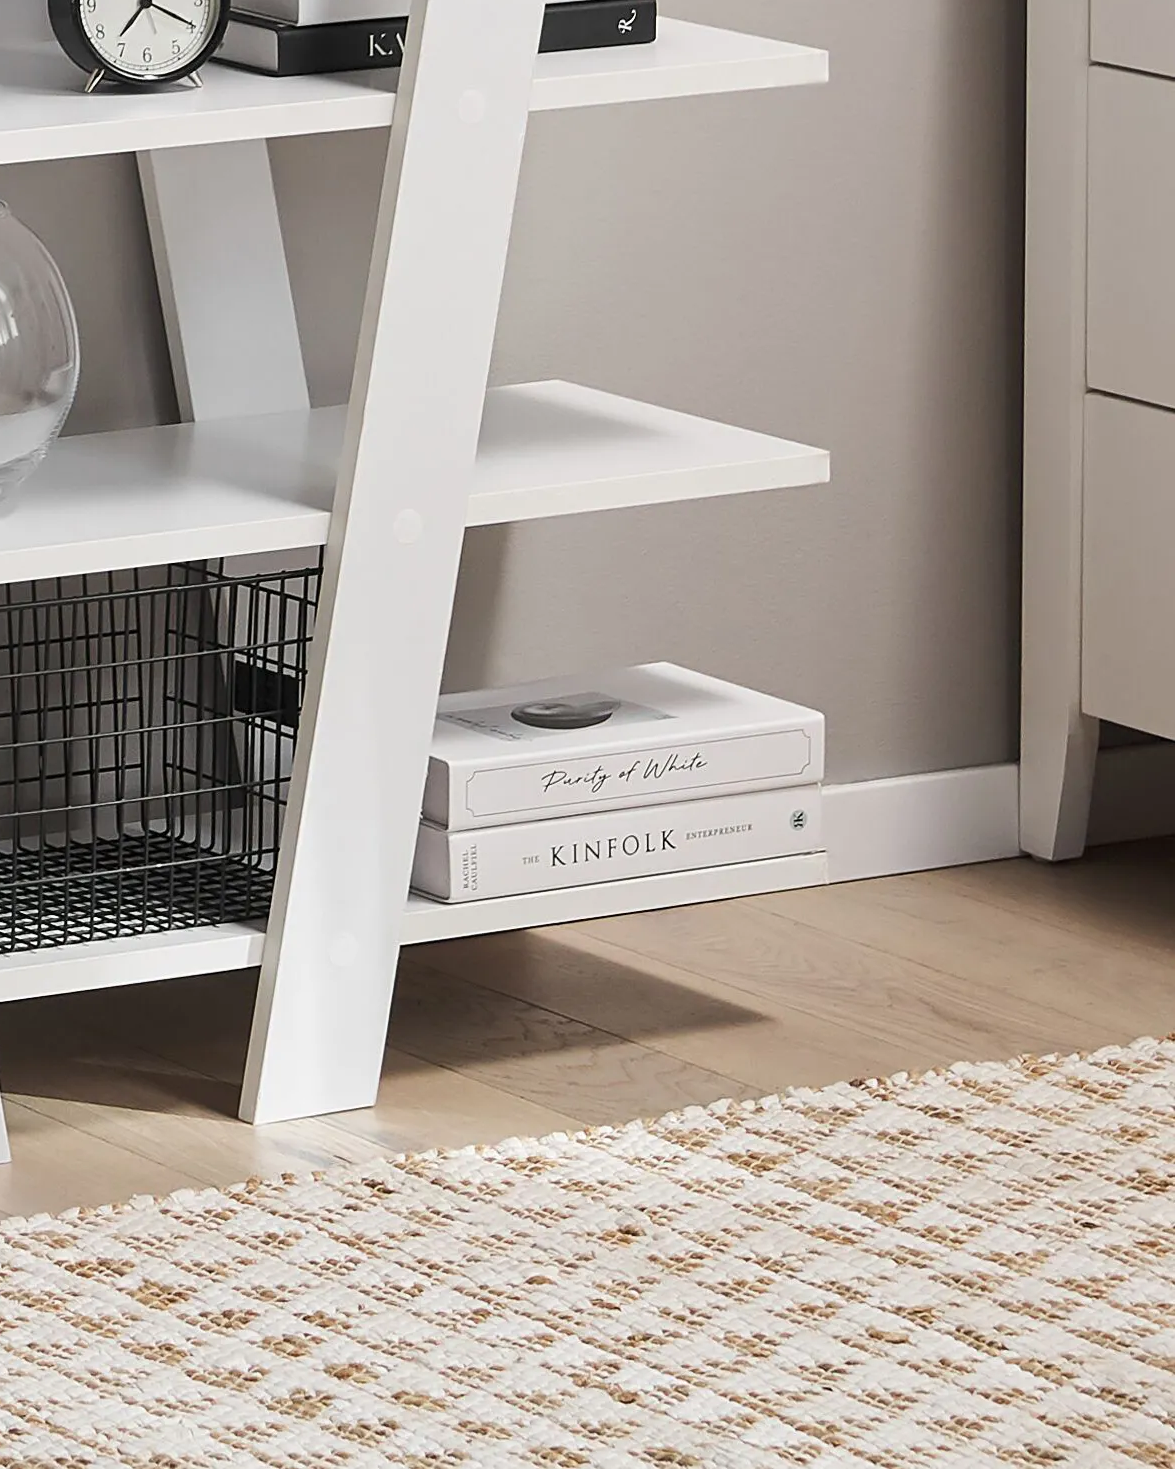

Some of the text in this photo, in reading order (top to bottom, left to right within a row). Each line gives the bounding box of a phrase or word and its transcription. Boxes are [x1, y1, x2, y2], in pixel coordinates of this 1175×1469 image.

[95, 23, 106, 40] 8
[116, 42, 126, 58] 7
[142, 47, 153, 63] 6
[171, 40, 181, 55] 5
[541, 752, 708, 794] Purity of White
[522, 855, 540, 865] THE
[551, 829, 677, 867] KINFOLK
[462, 849, 470, 889] RACHEL
